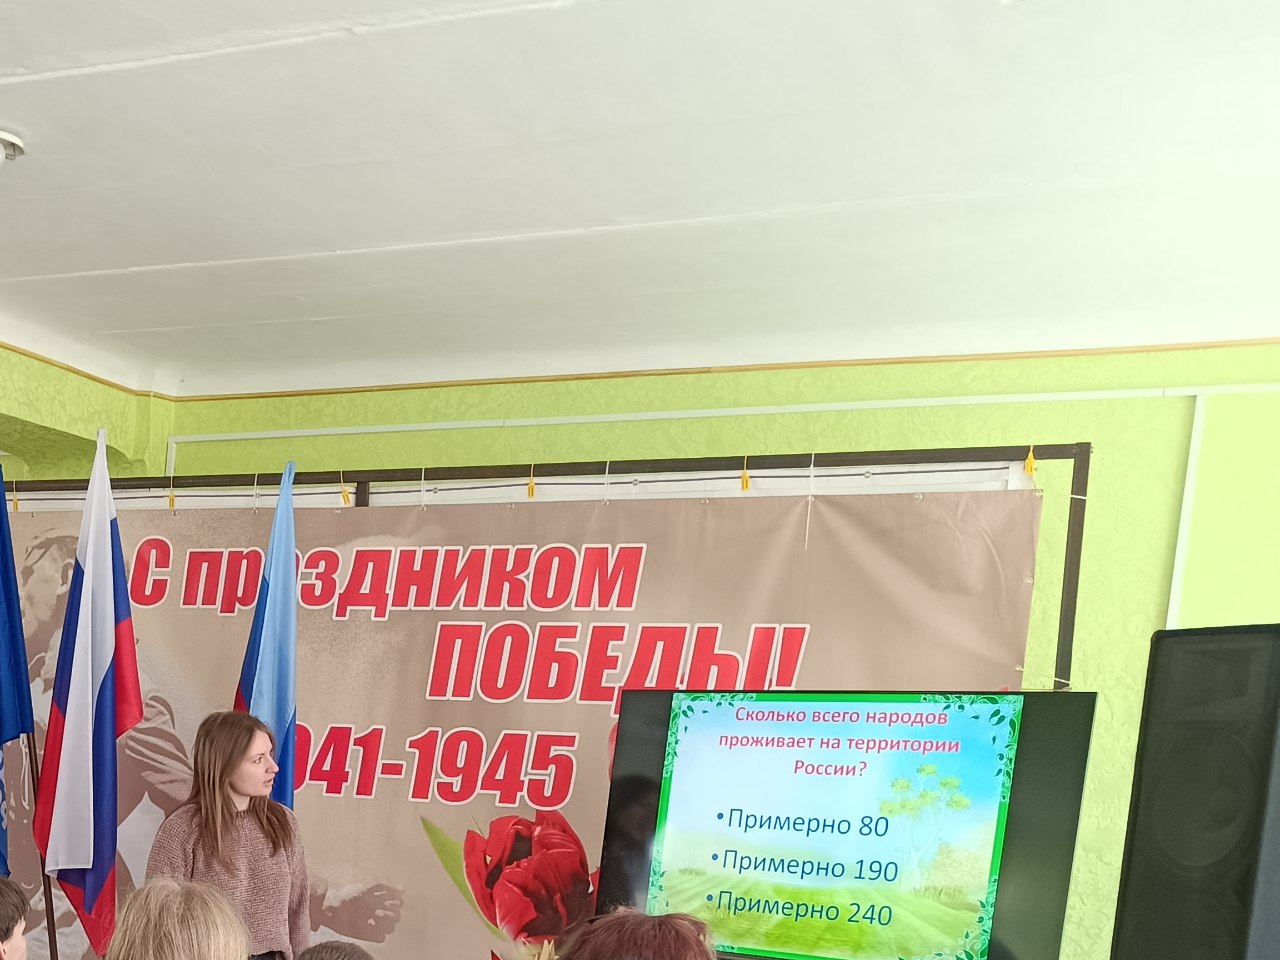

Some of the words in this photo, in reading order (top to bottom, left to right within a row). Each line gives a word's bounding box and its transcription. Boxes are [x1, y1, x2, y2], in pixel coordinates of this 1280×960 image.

[128, 535, 173, 609] С
[180, 543, 647, 621] прздником
[735, 706, 807, 722] Сколько
[811, 710, 861, 724] всего
[865, 710, 949, 728] народов
[718, 734, 816, 750] проживает
[819, 737, 841, 750] на
[846, 738, 961, 755] территории
[793, 759, 868, 777] России?
[728, 808, 852, 838] Примерно
[858, 815, 889, 838] 80
[722, 849, 846, 880] Примерно
[853, 859, 899, 882] 190
[717, 890, 840, 923] Примерно
[847, 902, 893, 926] 240
